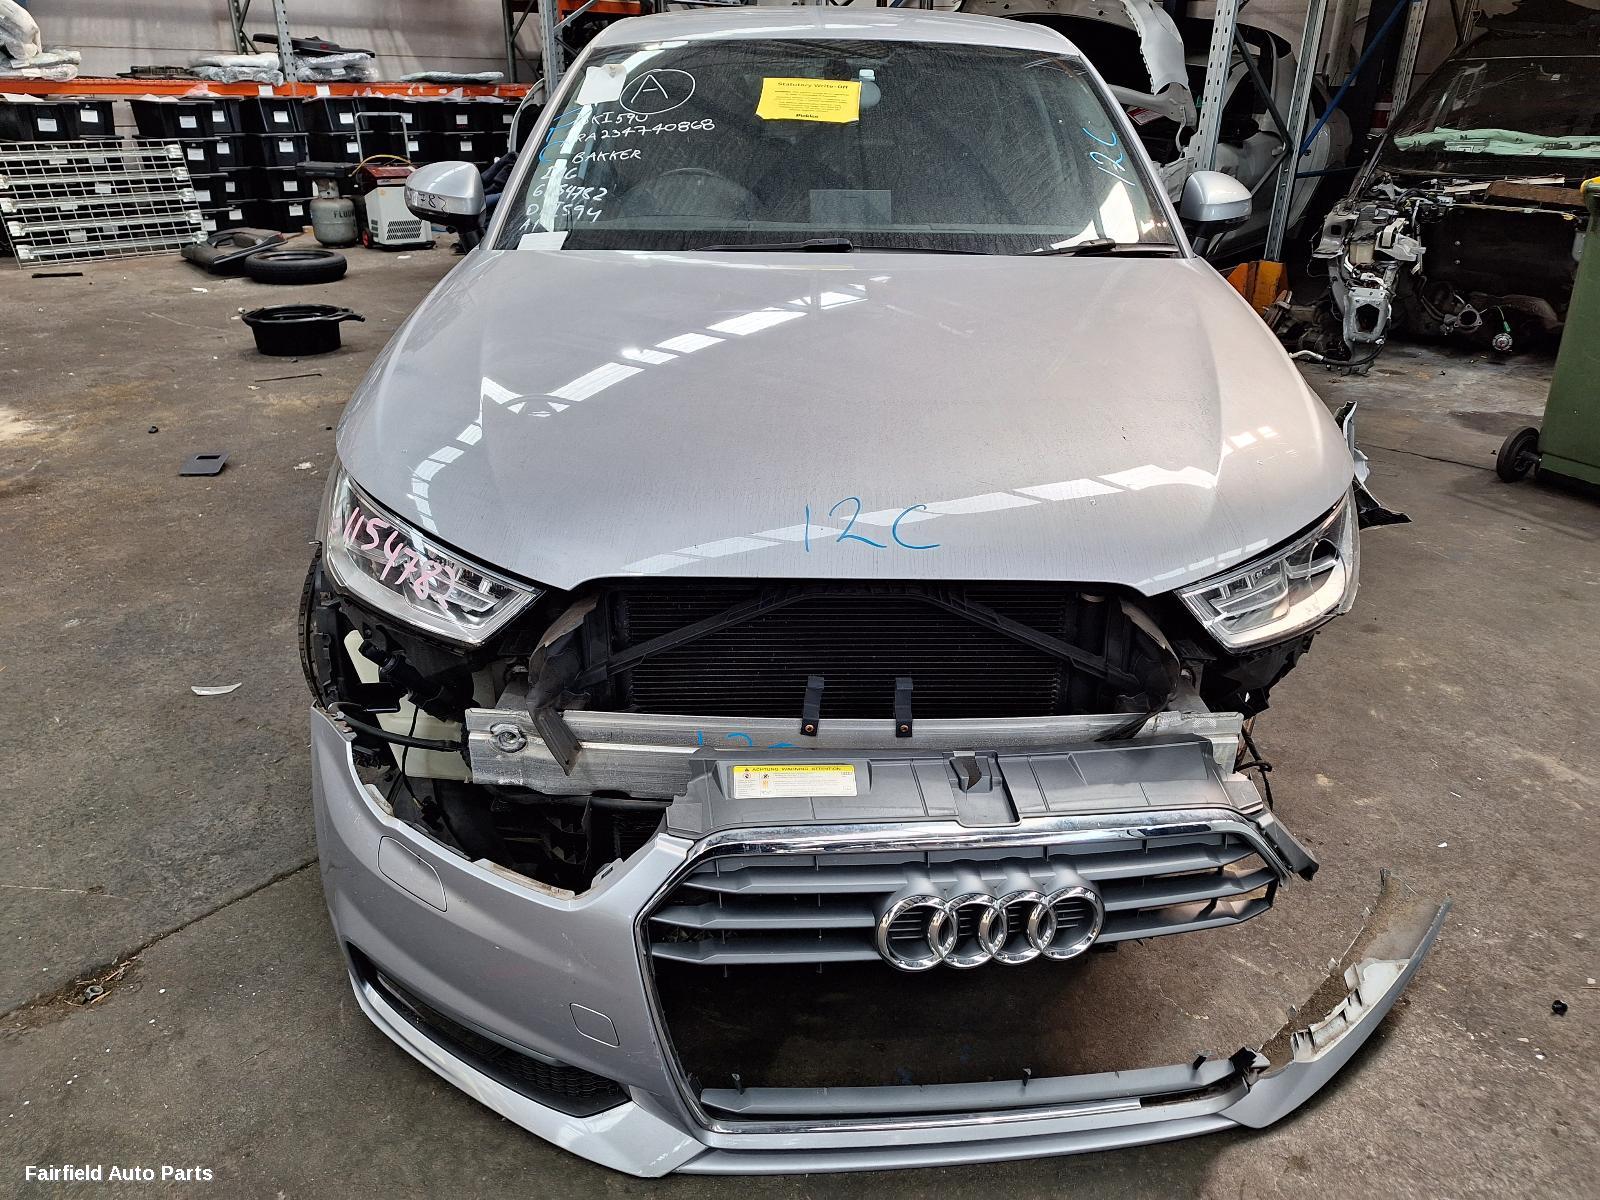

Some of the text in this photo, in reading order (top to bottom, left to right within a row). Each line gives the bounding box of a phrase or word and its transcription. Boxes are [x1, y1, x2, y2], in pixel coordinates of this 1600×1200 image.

[630, 74, 669, 104] A
[571, 149, 642, 165] BAKKER
[804, 496, 941, 553] 12C
